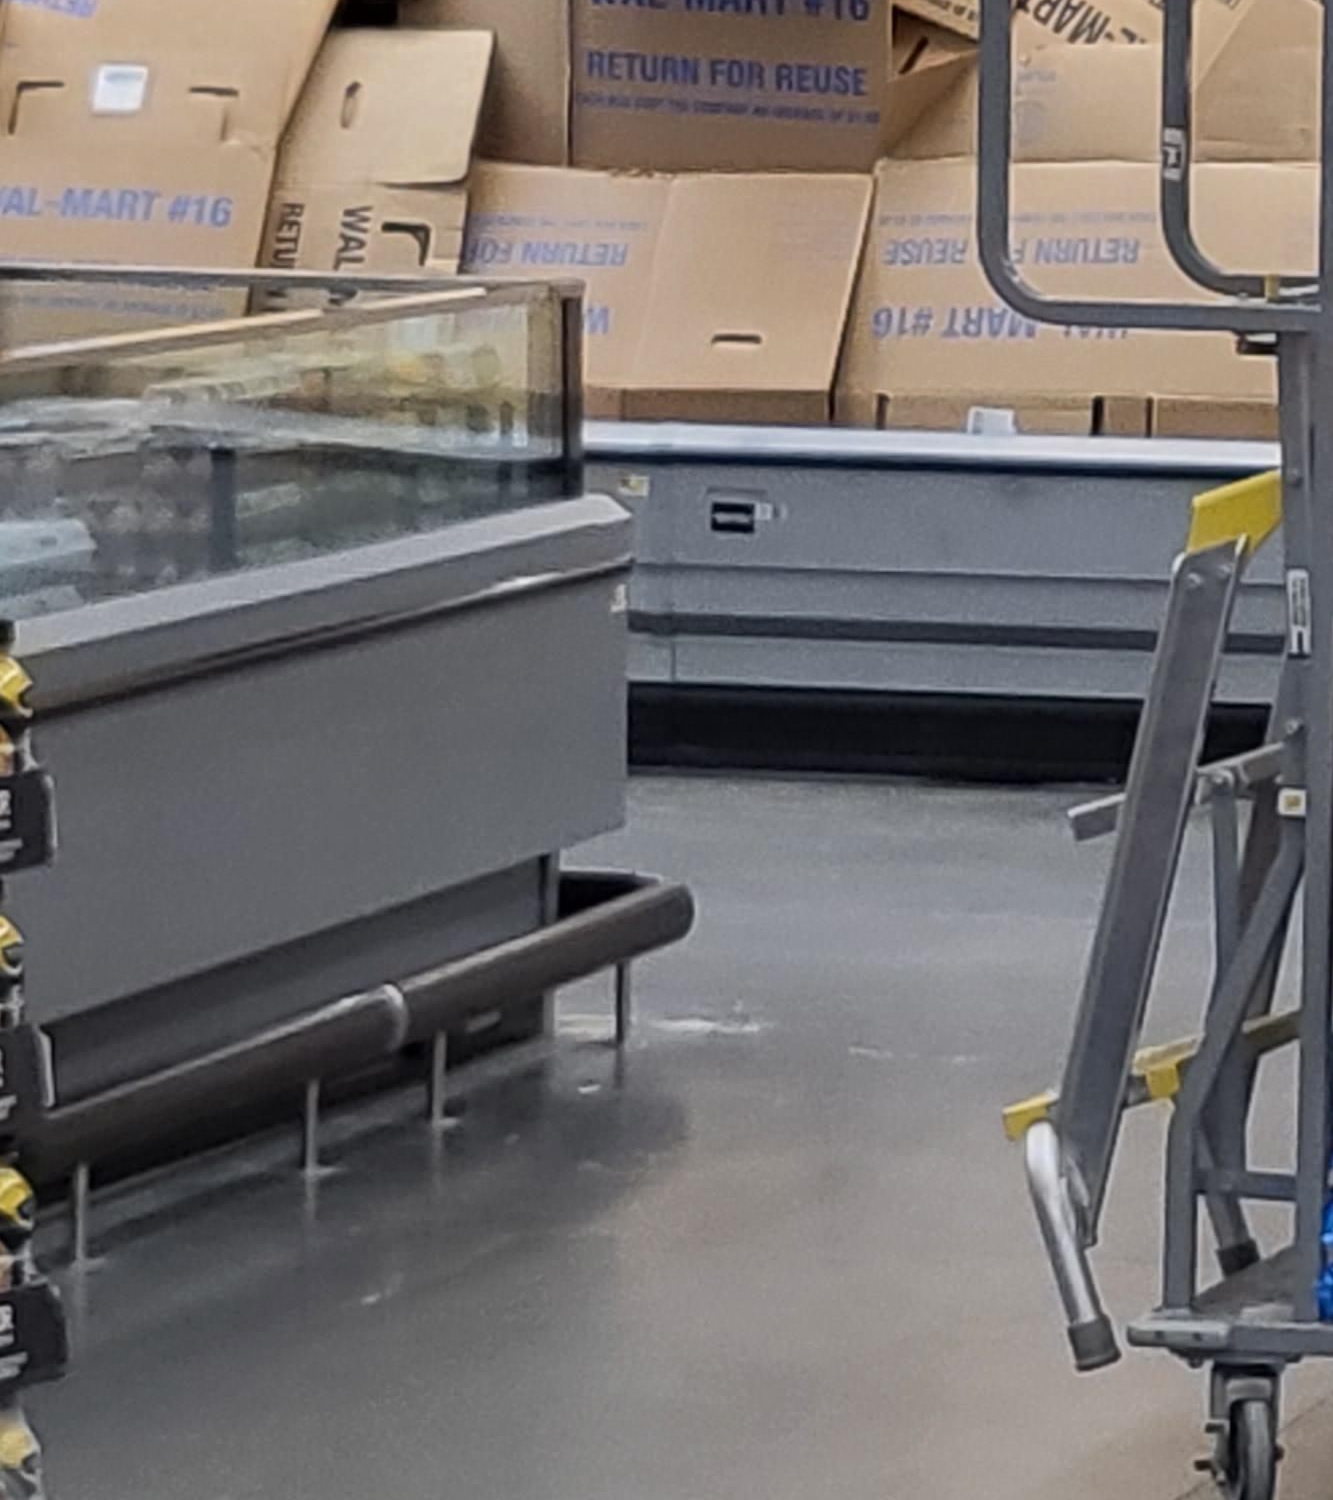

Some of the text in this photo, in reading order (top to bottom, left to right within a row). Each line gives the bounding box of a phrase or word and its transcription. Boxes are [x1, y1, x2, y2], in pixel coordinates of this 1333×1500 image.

[588, 50, 869, 97] RETURN FOR REUSE
[0, 184, 235, 228] AL-MART #16
[521, 240, 629, 267] RETURN
[885, 236, 969, 267] REUSE
[1035, 236, 1141, 265] RETURN
[871, 305, 934, 341] #16
